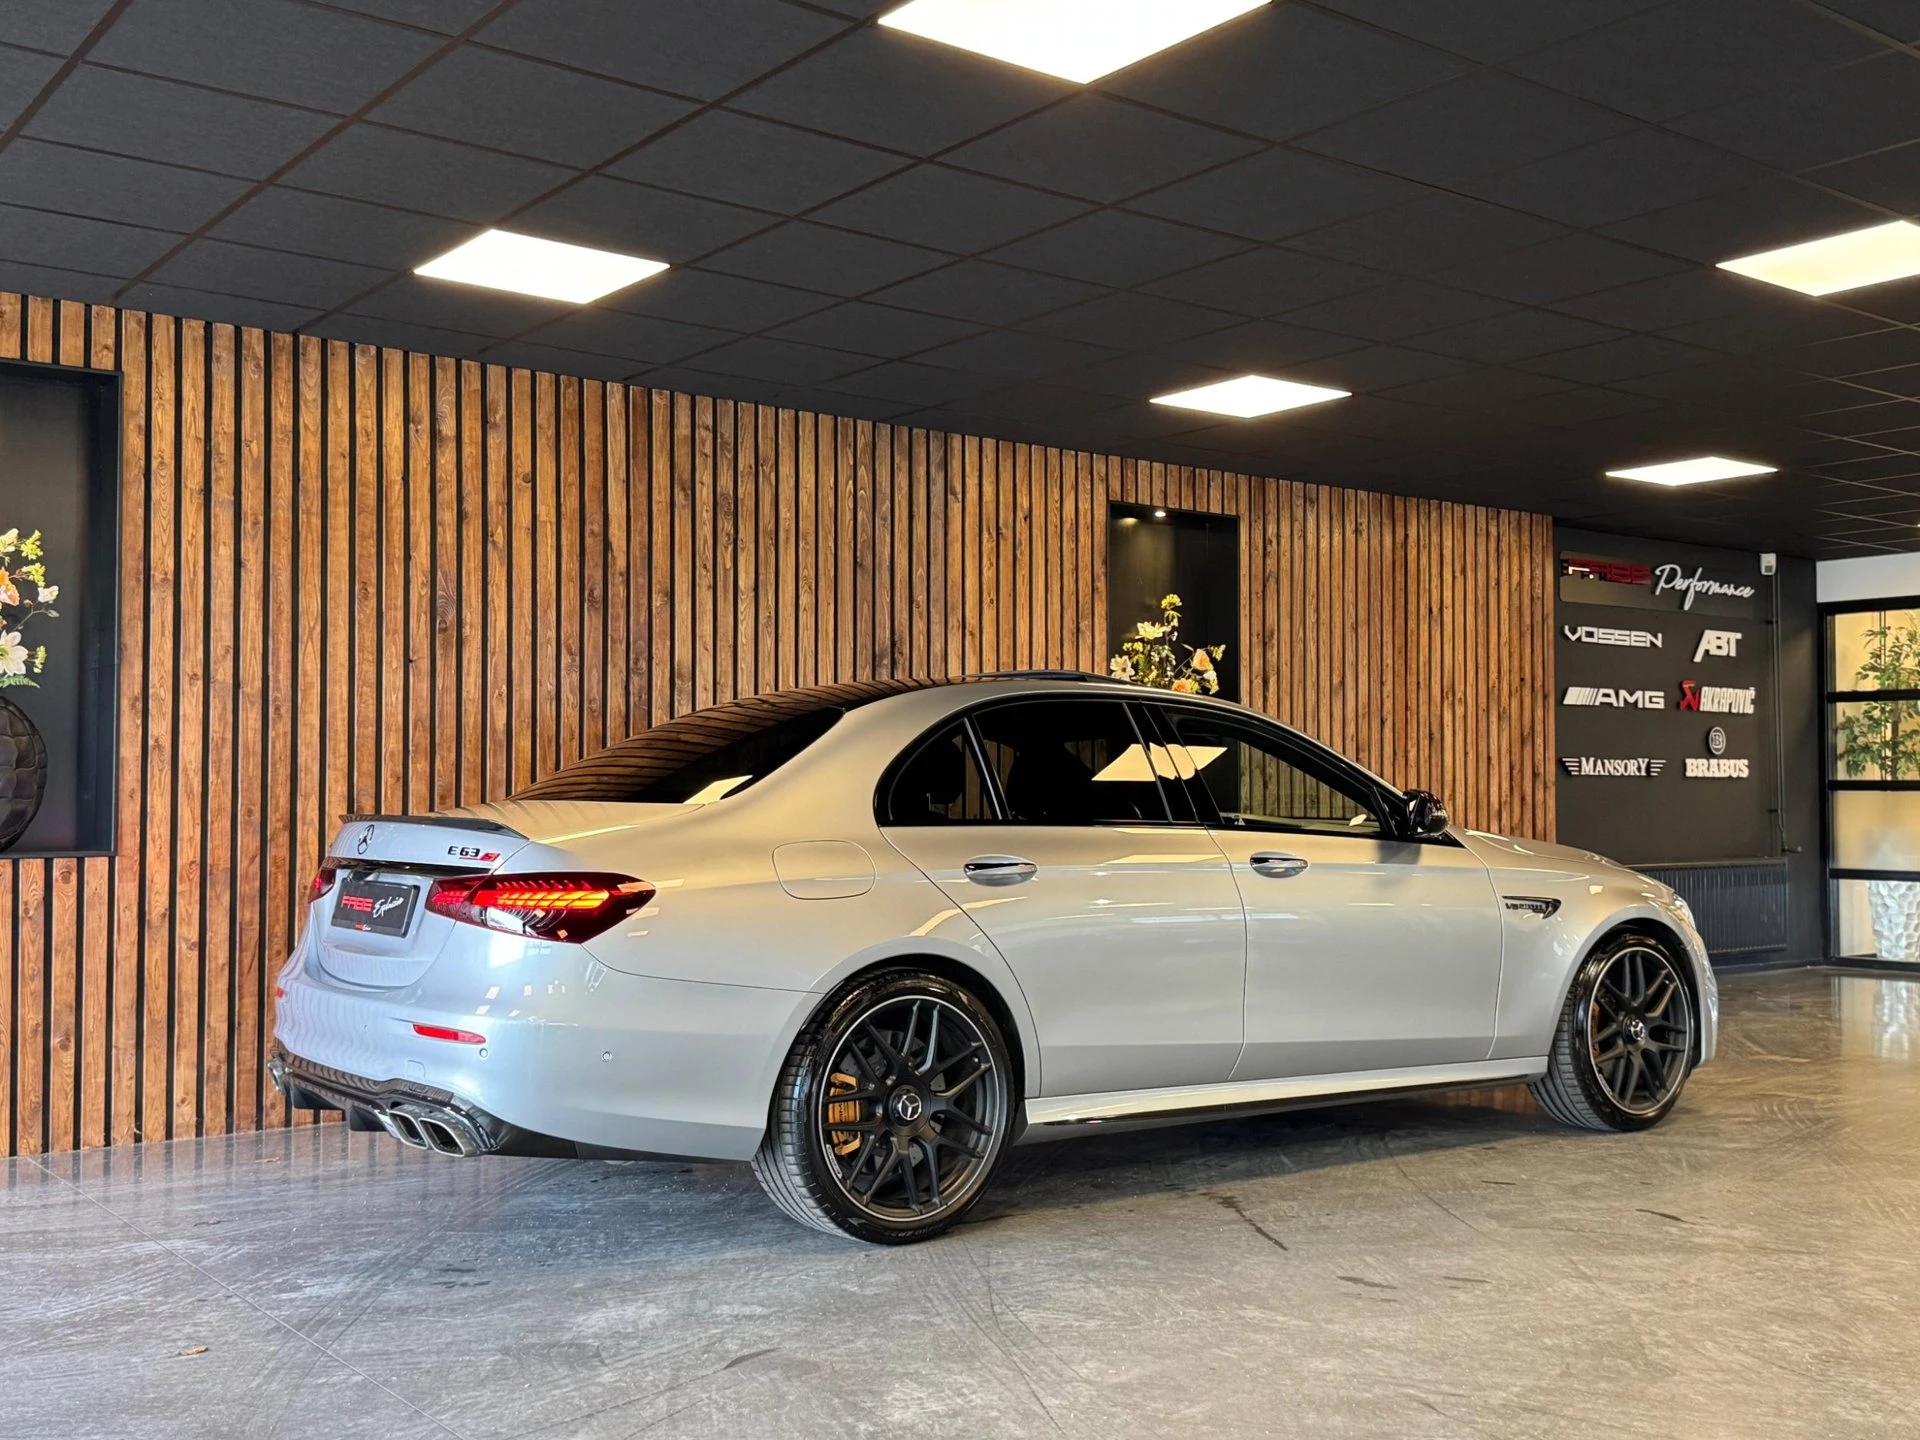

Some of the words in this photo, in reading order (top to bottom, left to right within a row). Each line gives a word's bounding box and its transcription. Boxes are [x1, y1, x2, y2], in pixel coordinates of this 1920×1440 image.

[1655, 563, 1755, 611] Performance
[1564, 624, 1663, 648] VOSSEN
[1693, 629, 1743, 663] ABT
[1594, 688, 1666, 710] AMG
[1580, 756, 1650, 777] MANSORY
[1685, 758, 1750, 778] BRABUS
